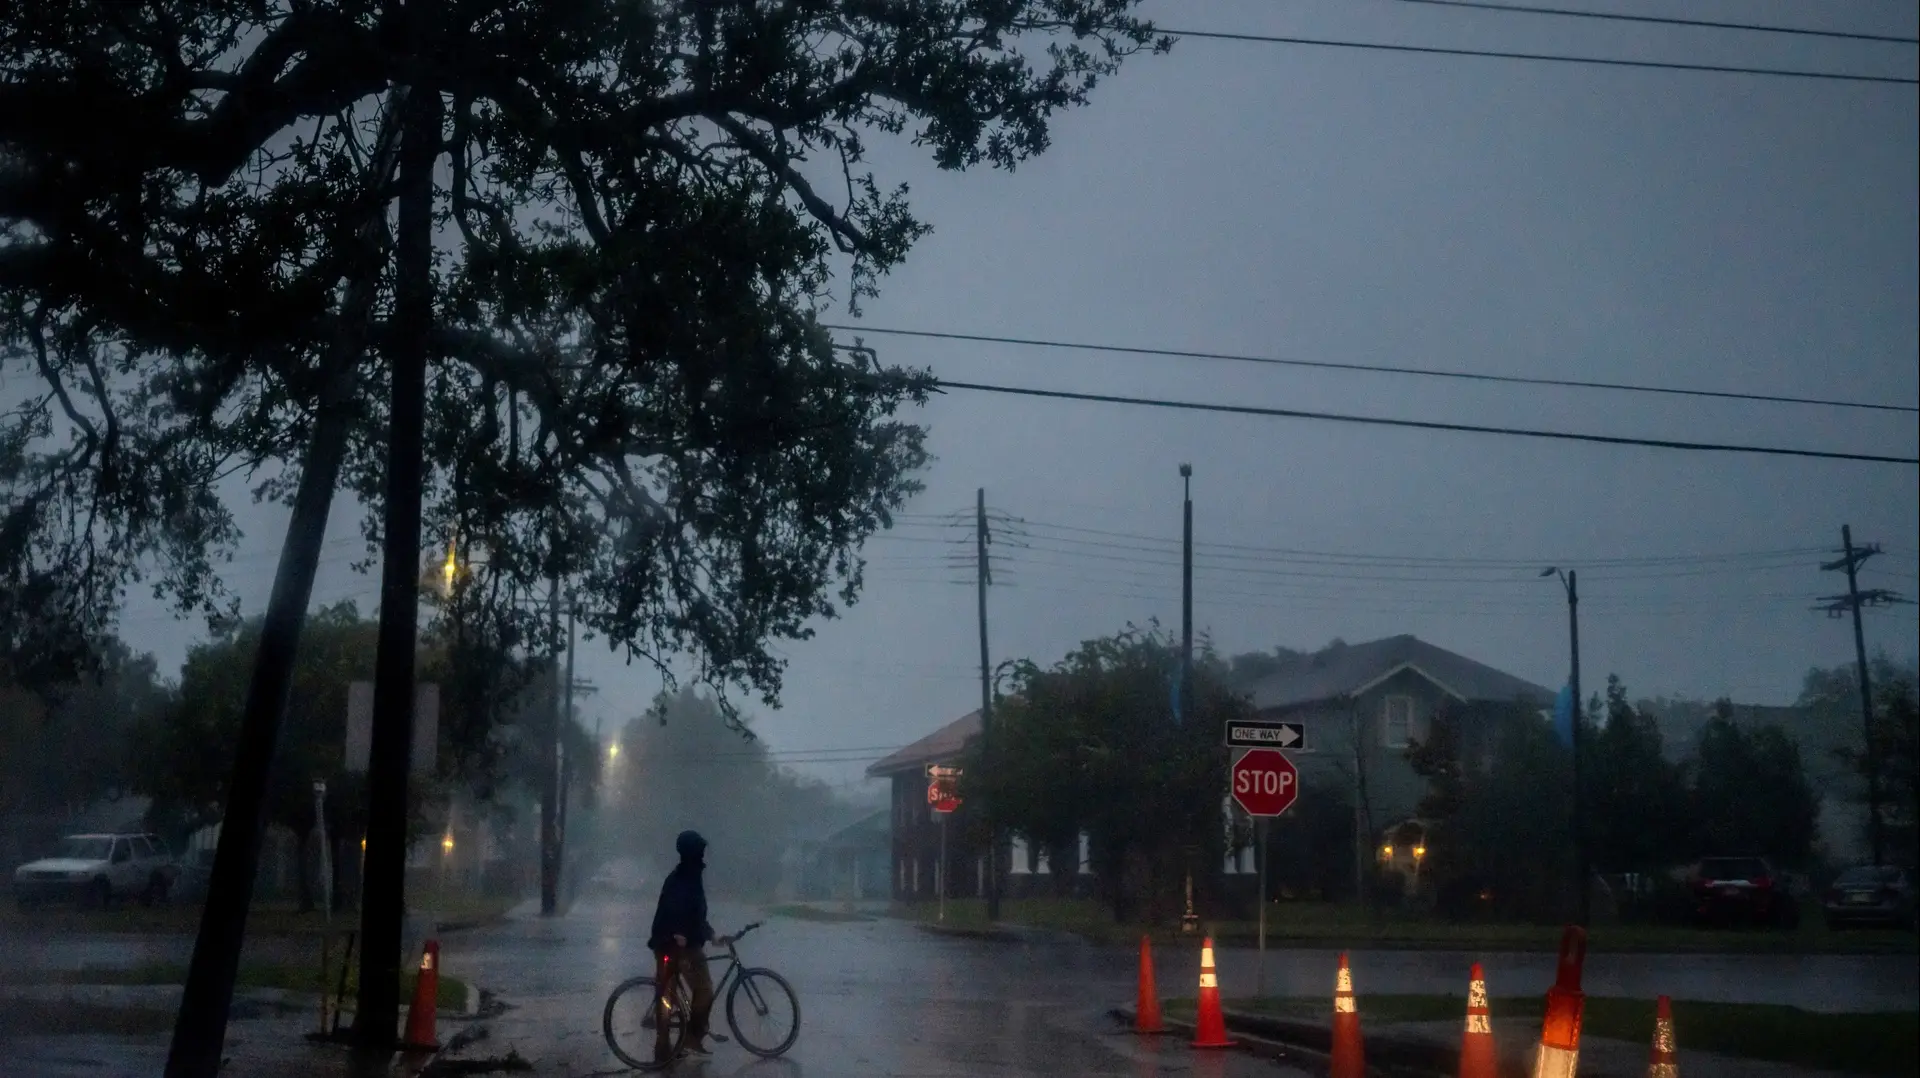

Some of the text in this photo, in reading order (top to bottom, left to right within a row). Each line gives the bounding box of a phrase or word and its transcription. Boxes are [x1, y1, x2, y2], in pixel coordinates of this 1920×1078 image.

[1234, 728, 1280, 740] ONE WAY
[1236, 769, 1294, 795] STOP
